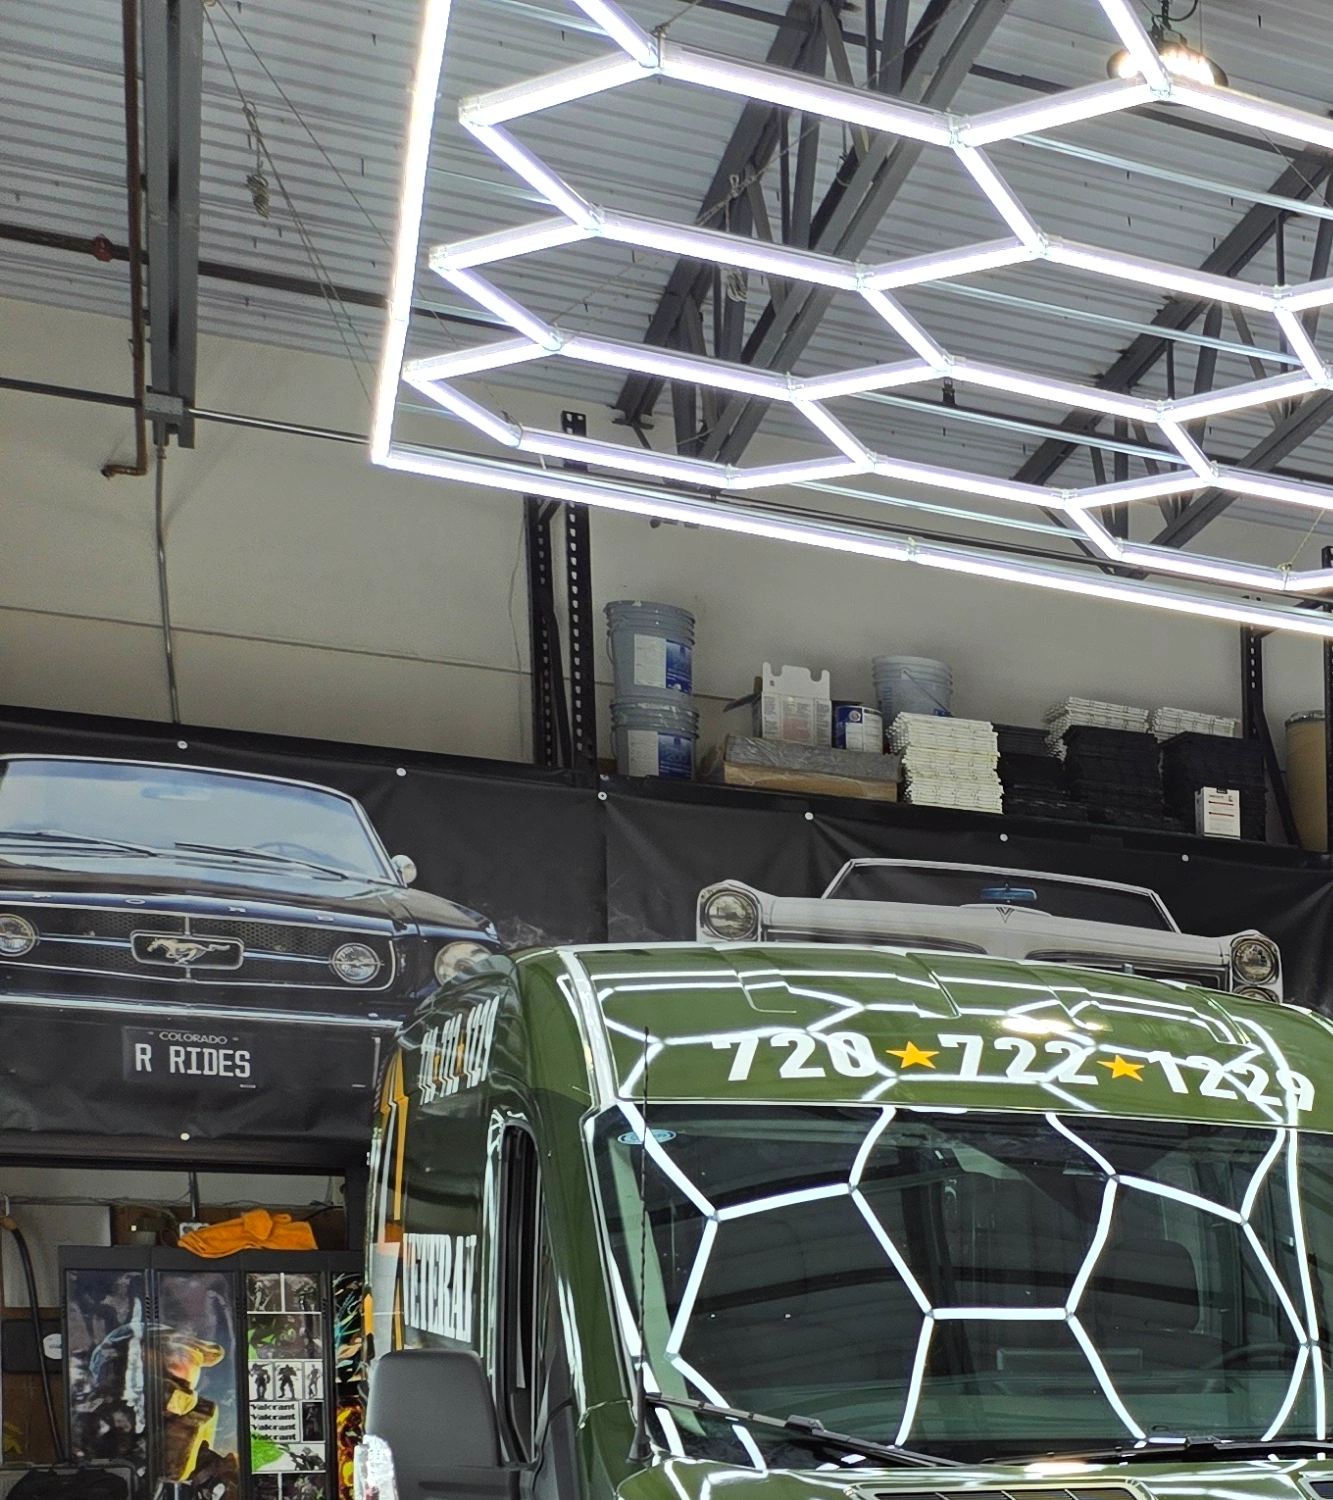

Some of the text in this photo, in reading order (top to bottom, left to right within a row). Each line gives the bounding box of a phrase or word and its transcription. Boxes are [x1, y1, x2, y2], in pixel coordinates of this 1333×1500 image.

[159, 1031, 228, 1045] COLORADO
[135, 1043, 250, 1078] R RIDES
[711, 1032, 876, 1081] 720
[937, 1033, 1099, 1085] 722
